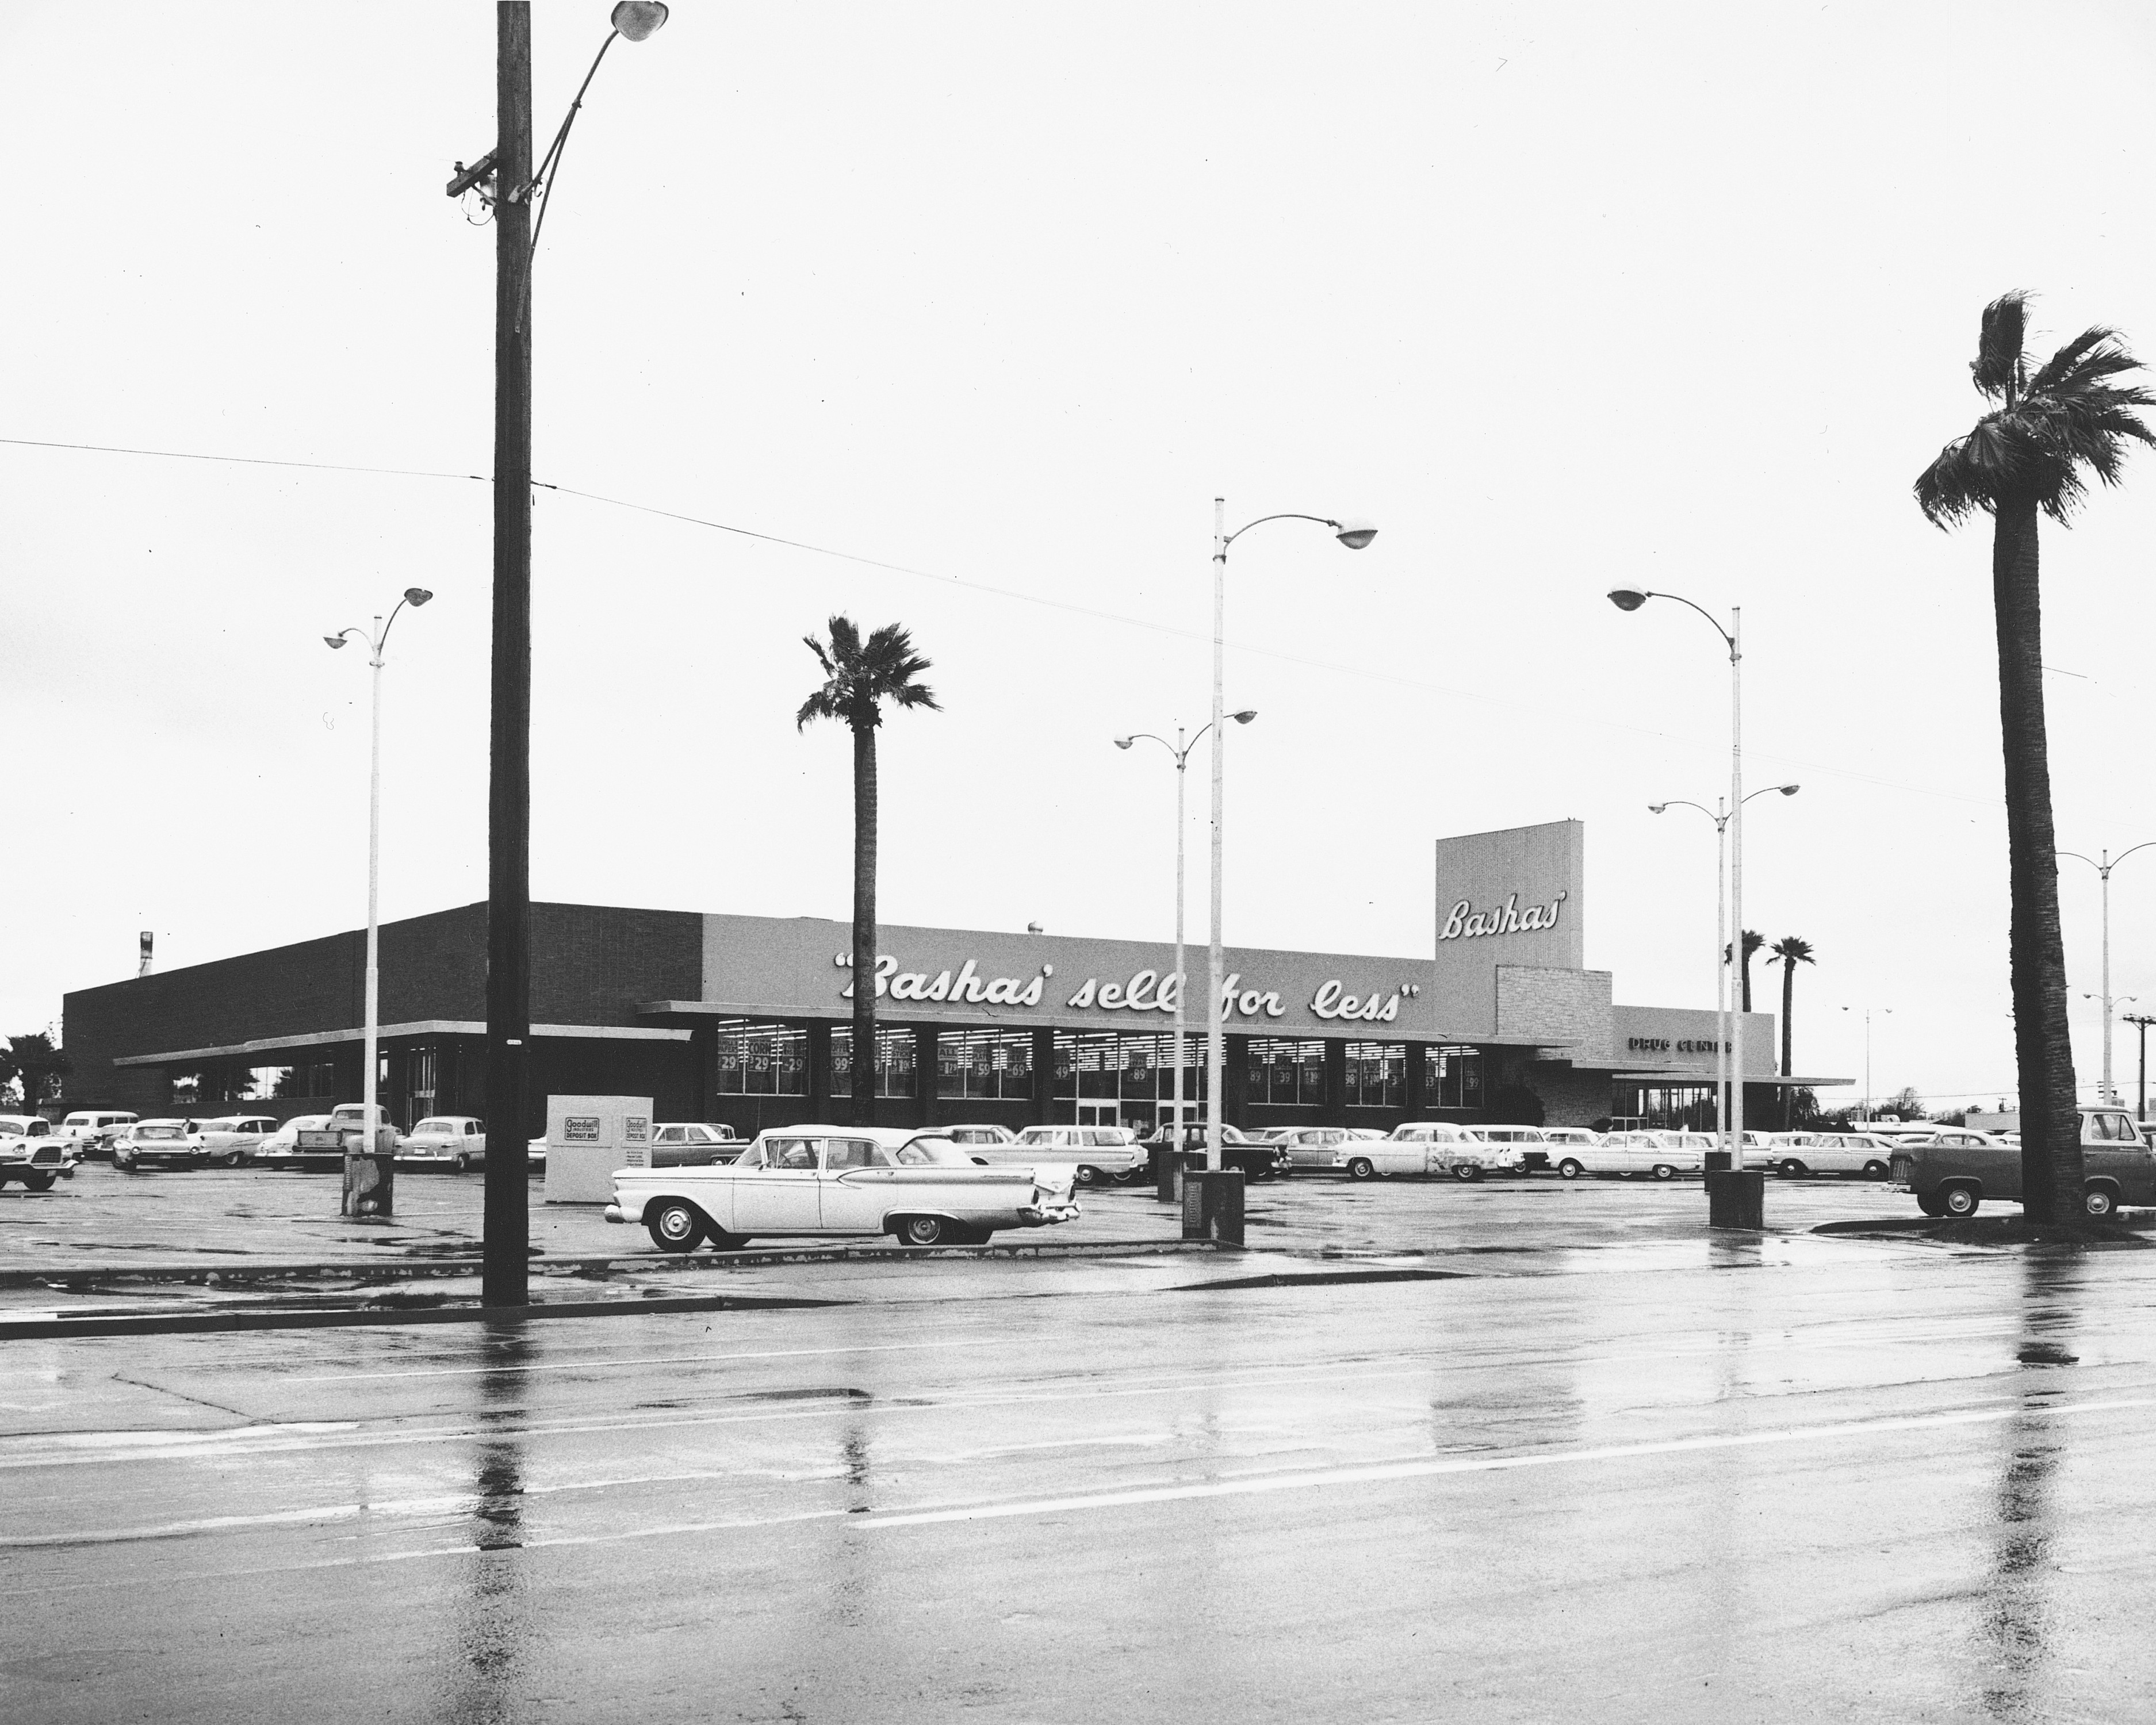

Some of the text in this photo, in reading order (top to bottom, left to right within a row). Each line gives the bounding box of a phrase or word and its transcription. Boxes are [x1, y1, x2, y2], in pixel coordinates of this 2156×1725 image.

[1438, 890, 1567, 940] Bashas'
[1067, 969, 1187, 1013] sell
[1219, 973, 1285, 1022] for
[748, 1042, 772, 1055] CORN
[1629, 1037, 1671, 1051] DRUG
[722, 1056, 736, 1069] 29
[755, 1056, 769, 1070] 29
[789, 1058, 803, 1071] 29
[834, 1057, 848, 1070] 99
